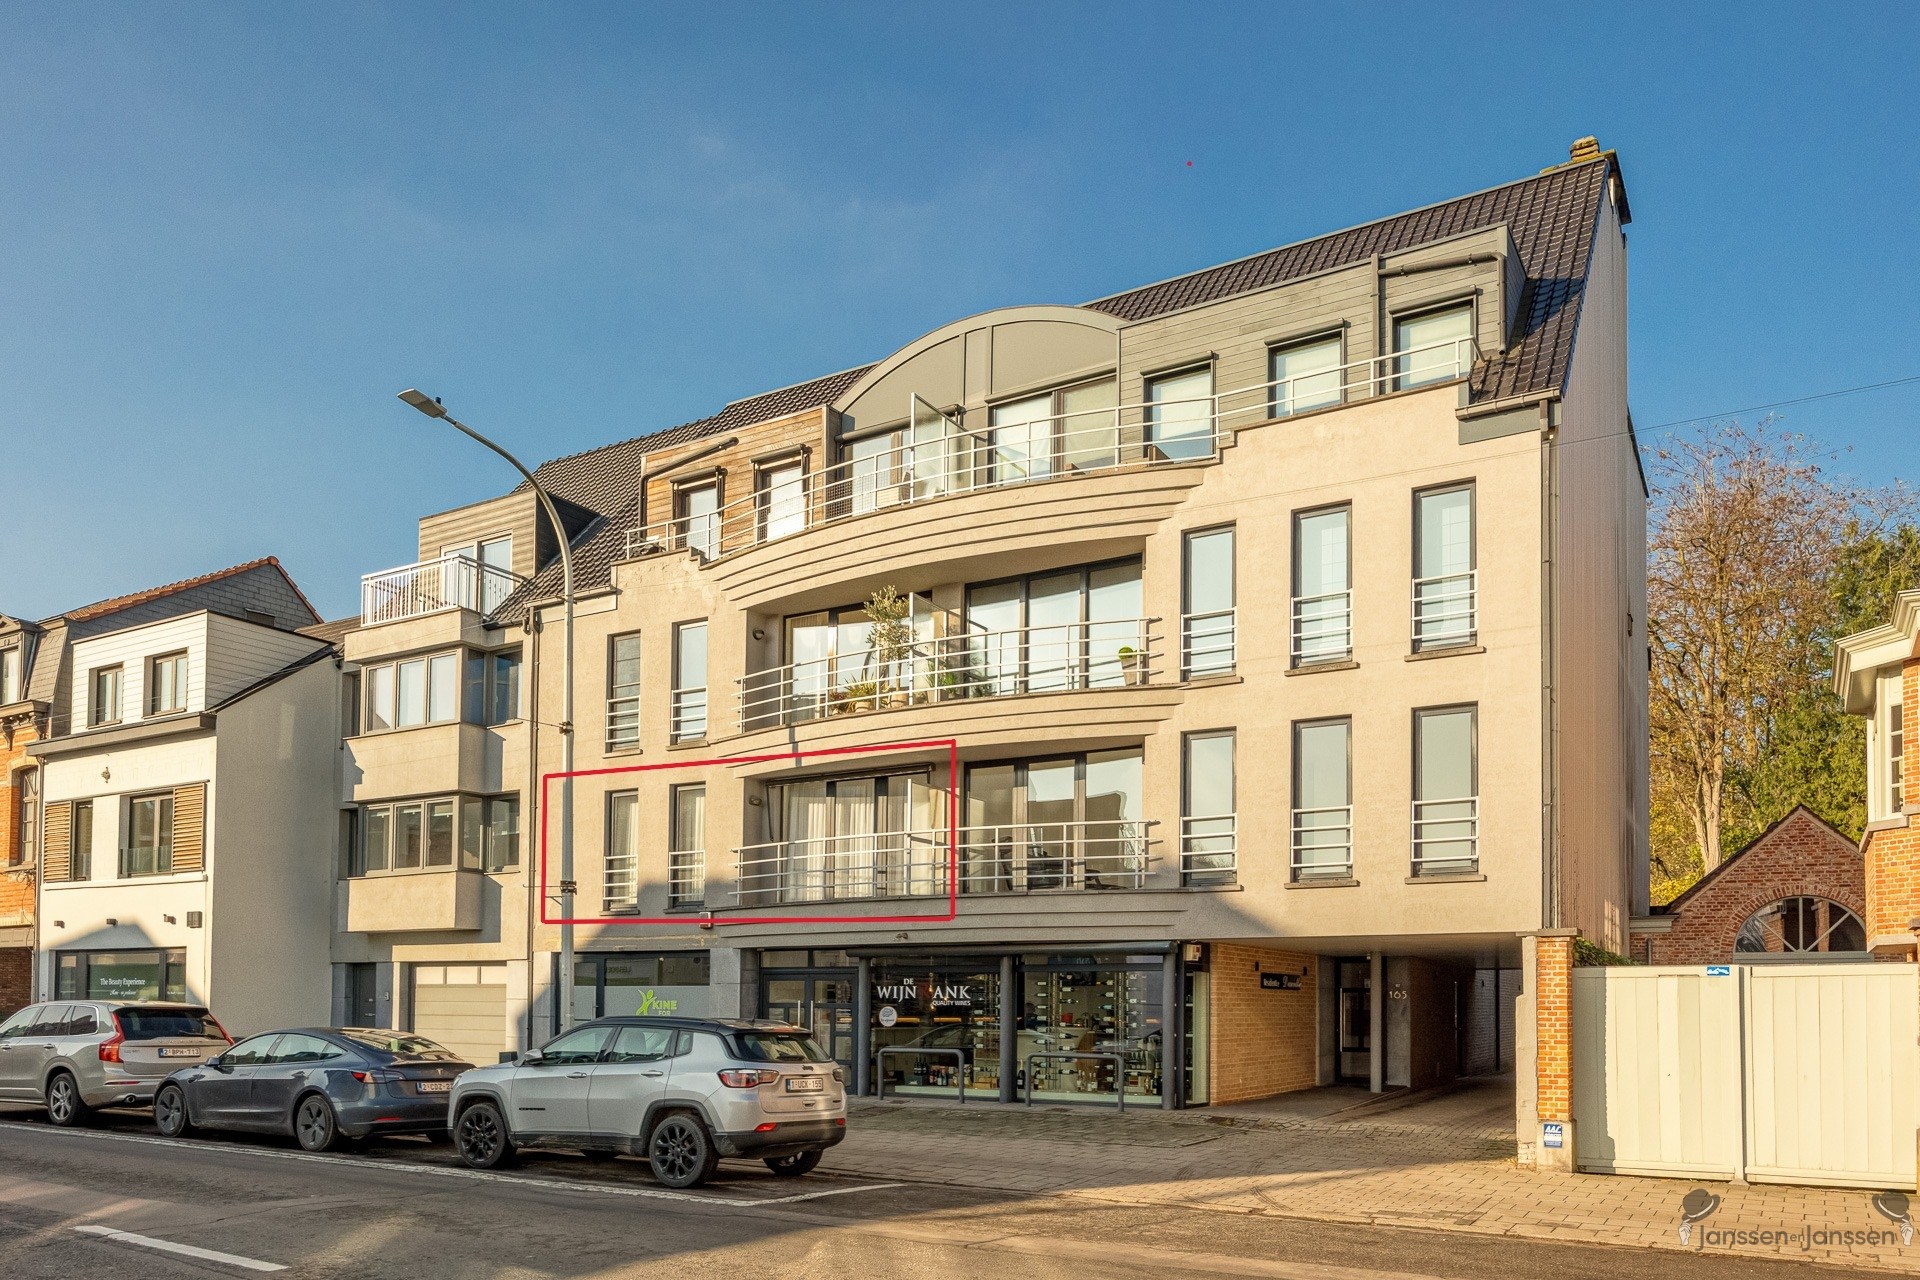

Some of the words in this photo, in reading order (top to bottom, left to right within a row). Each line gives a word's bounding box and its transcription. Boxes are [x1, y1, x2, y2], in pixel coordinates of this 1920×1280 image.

[108, 978, 122, 987] Beauty
[877, 985, 917, 1002] WIJN
[1389, 990, 1407, 999] 165
[652, 1000, 678, 1010] KINE
